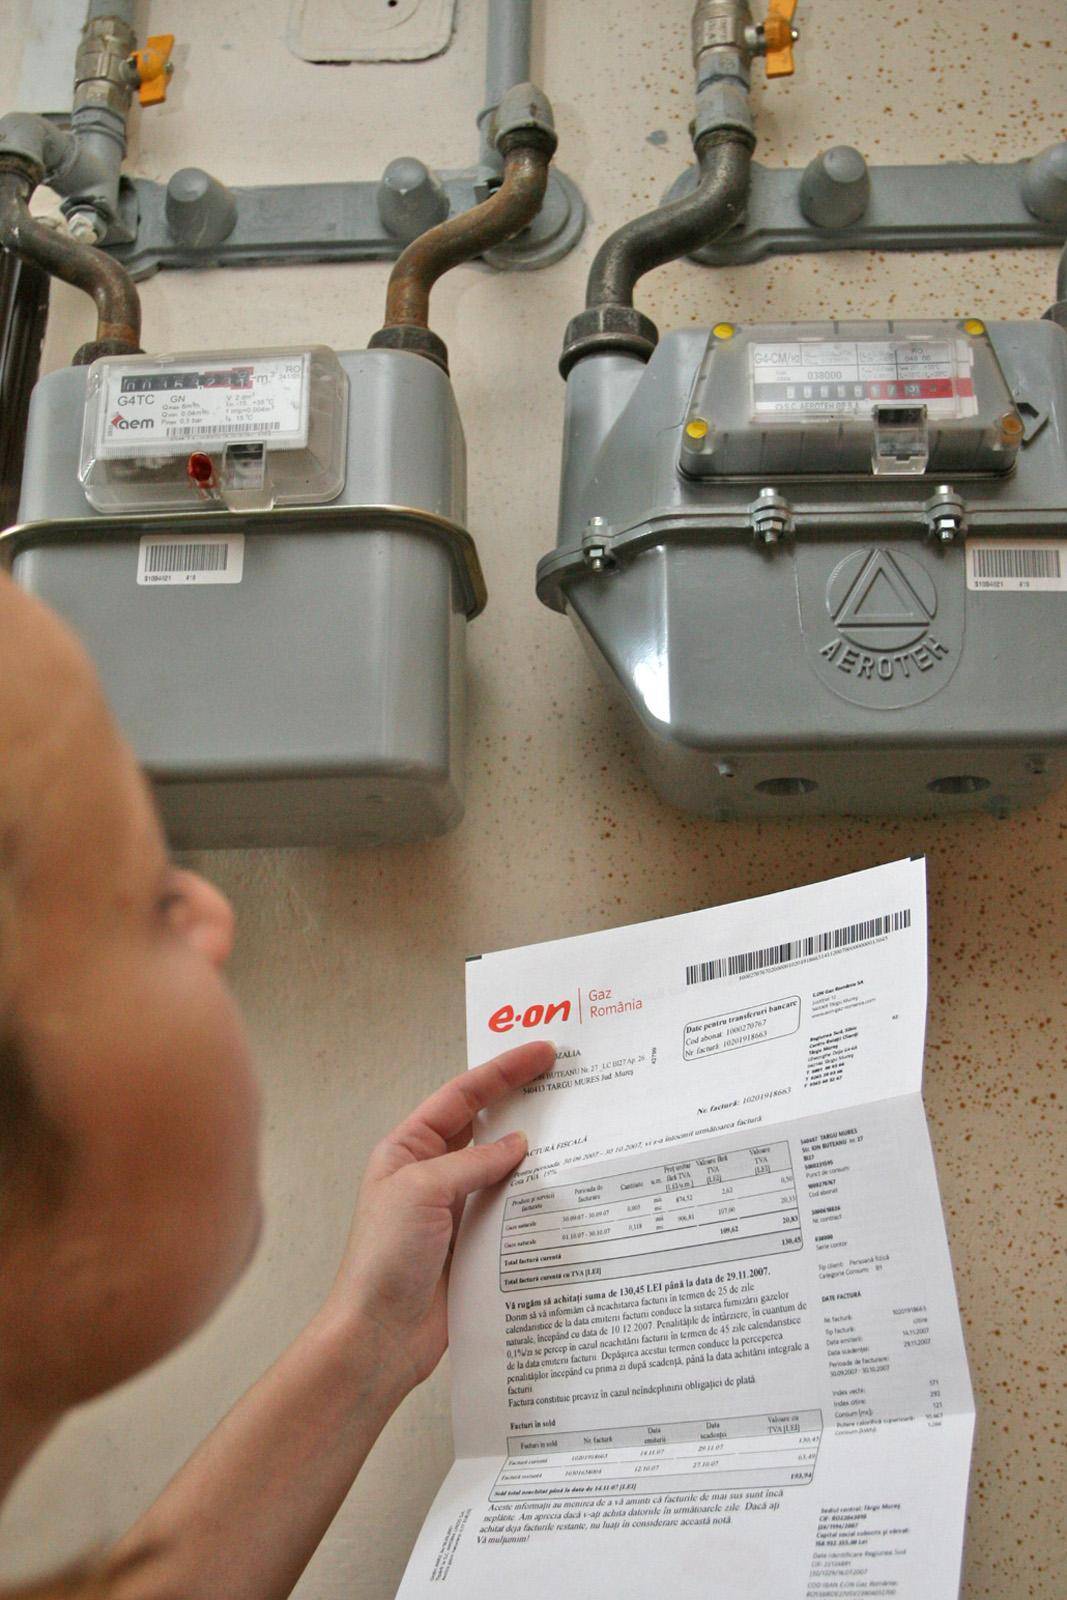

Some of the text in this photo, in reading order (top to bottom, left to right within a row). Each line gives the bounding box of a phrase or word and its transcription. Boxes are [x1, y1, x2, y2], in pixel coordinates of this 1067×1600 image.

[118, 395, 154, 406] G4TC
[119, 419, 154, 429] aem
[819, 636, 949, 680] AEROTEH
[589, 989, 611, 1001] Gaz
[590, 998, 643, 1018] România
[686, 1025, 702, 1034] Date
[704, 1018, 726, 1031] pentru
[729, 1009, 767, 1023] transferuri
[769, 1000, 797, 1013] bancare
[686, 1019, 767, 1046] Cod abonat 1000270767
[547, 1076, 600, 1091] TARGU MURES
[506, 1302, 516, 1310] Vă
[518, 1299, 541, 1309] rugăm
[620, 1286, 645, 1296] 130,45
[647, 1285, 662, 1293] LEI
[665, 1280, 684, 1292] până
[686, 1279, 693, 1287] la
[695, 1276, 713, 1286] data
[715, 1275, 725, 1283] de
[727, 1267, 770, 1281] 29.11.2007.
[505, 1313, 527, 1322] Dorim
[549, 1306, 584, 1317] informăm
[597, 1300, 639, 1311] neachitarea
[641, 1295, 667, 1306] facturii
[679, 1291, 705, 1301] termen
[707, 1289, 716, 1297] de
[718, 1287, 728, 1295] 25
[729, 1286, 738, 1294] de
[741, 1284, 755, 1292] zile
[505, 1323, 552, 1334] calendaristice
[574, 1318, 589, 1326] data
[591, 1316, 620, 1324] emiterii
[622, 1312, 649, 1321] facturii
[651, 1306, 682, 1316] conduce
[684, 1304, 691, 1312] la
[694, 1302, 722, 1312] sistarea
[724, 1297, 758, 1307] furnizării
[761, 1291, 789, 1303] gazelor
[581, 1329, 597, 1337] data
[599, 1327, 608, 1335] de
[701, 1315, 710, 1323] de
[762, 1304, 795, 1315] cuantum
[798, 1302, 807, 1310] de
[543, 1345, 567, 1355] percep
[579, 1342, 598, 1350] cazul
[600, 1338, 639, 1348] neachitării
[642, 1334, 668, 1344] facturii
[680, 1329, 707, 1339] termen
[708, 1327, 718, 1335] de
[720, 1326, 730, 1334] 45
[732, 1324, 746, 1332] zile
[748, 1317, 801, 1331] calendaristice
[525, 1360, 540, 1368] data
[541, 1357, 569, 1367] emiterii
[641, 1345, 667, 1356] acestui
[669, 1344, 696, 1353] termen
[698, 1340, 729, 1349] conduce
[732, 1337, 739, 1345] la
[741, 1334, 783, 1346] perceperea
[595, 1364, 617, 1375] prima
[628, 1361, 646, 1371] după
[686, 1356, 704, 1366] până
[707, 1354, 714, 1362] la
[716, 1352, 733, 1361] data
[734, 1348, 766, 1358] achitării
[768, 1343, 802, 1355] integrale
[508, 1398, 534, 1407] Factura
[536, 1395, 570, 1405] constituie
[572, 1391, 599, 1403] preaviz
[610, 1388, 629, 1396] cazul
[736, 1376, 755, 1387] plată
[543, 1419, 556, 1427] sold
[518, 1501, 766, 1521] Am aprecia dacă achita Dacă
[563, 1499, 594, 1508] menirea
[596, 1498, 606, 1506] de
[614, 1498, 623, 1506] vă
[652, 1495, 662, 1504] că
[664, 1494, 697, 1503] facturile
[699, 1492, 709, 1501] de
[745, 1490, 763, 1499] sunt
[479, 1524, 504, 1533] achitat
[506, 1524, 521, 1533] deja
[632, 1517, 678, 1528] considerare
[680, 1515, 710, 1525] această
[476, 1536, 487, 1544] Vă
